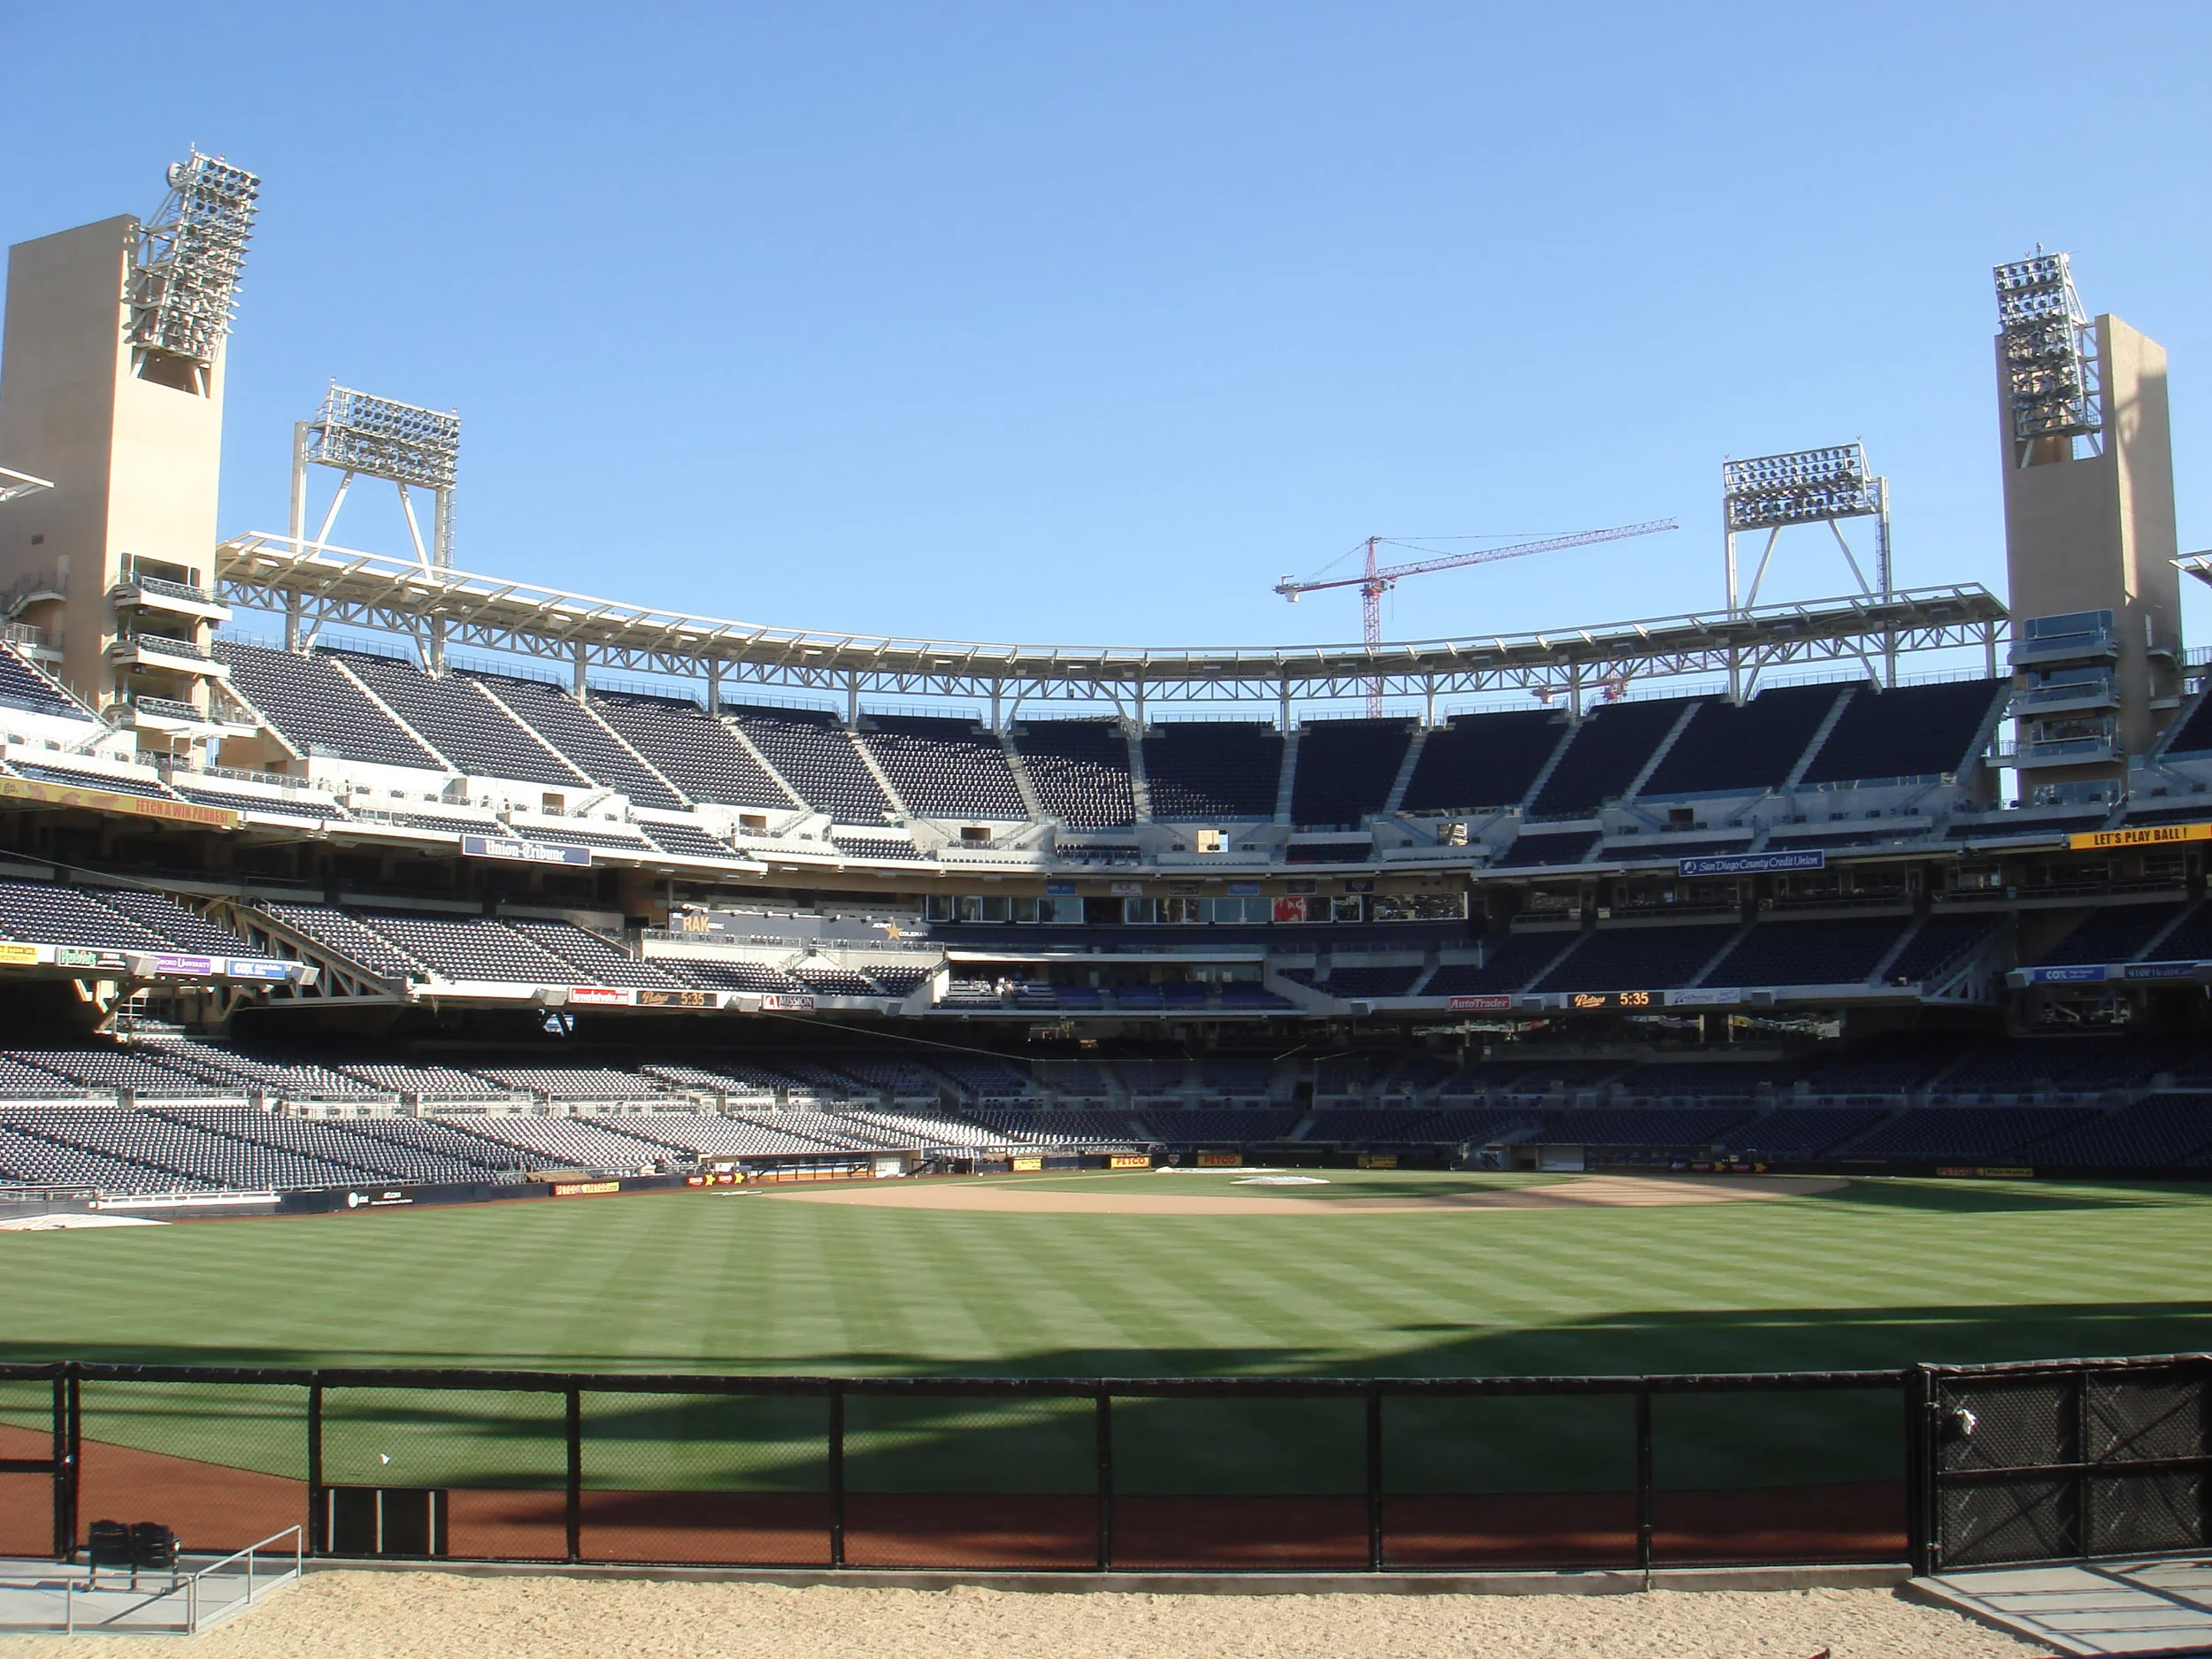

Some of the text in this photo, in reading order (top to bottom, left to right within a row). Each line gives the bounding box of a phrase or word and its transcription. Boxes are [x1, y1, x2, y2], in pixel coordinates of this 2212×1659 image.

[136, 799, 227, 824] FETCH A WIN PADRES!
[2094, 833, 2121, 845] LET'S
[2125, 831, 2150, 843] PLAY
[2154, 828, 2179, 840] BALL
[485, 840, 566, 861] Union-Tribune
[1699, 856, 1818, 872] San Diego County Credit Union
[683, 915, 709, 932] RAK
[2046, 970, 2068, 979] COX
[641, 992, 705, 1005] Padres 5:35
[780, 996, 812, 1005] MISSION
[1451, 998, 1508, 1009] AutoTrader
[1574, 993, 1649, 1008] Padres 5:35
[1204, 1156, 1236, 1164] PETCO
